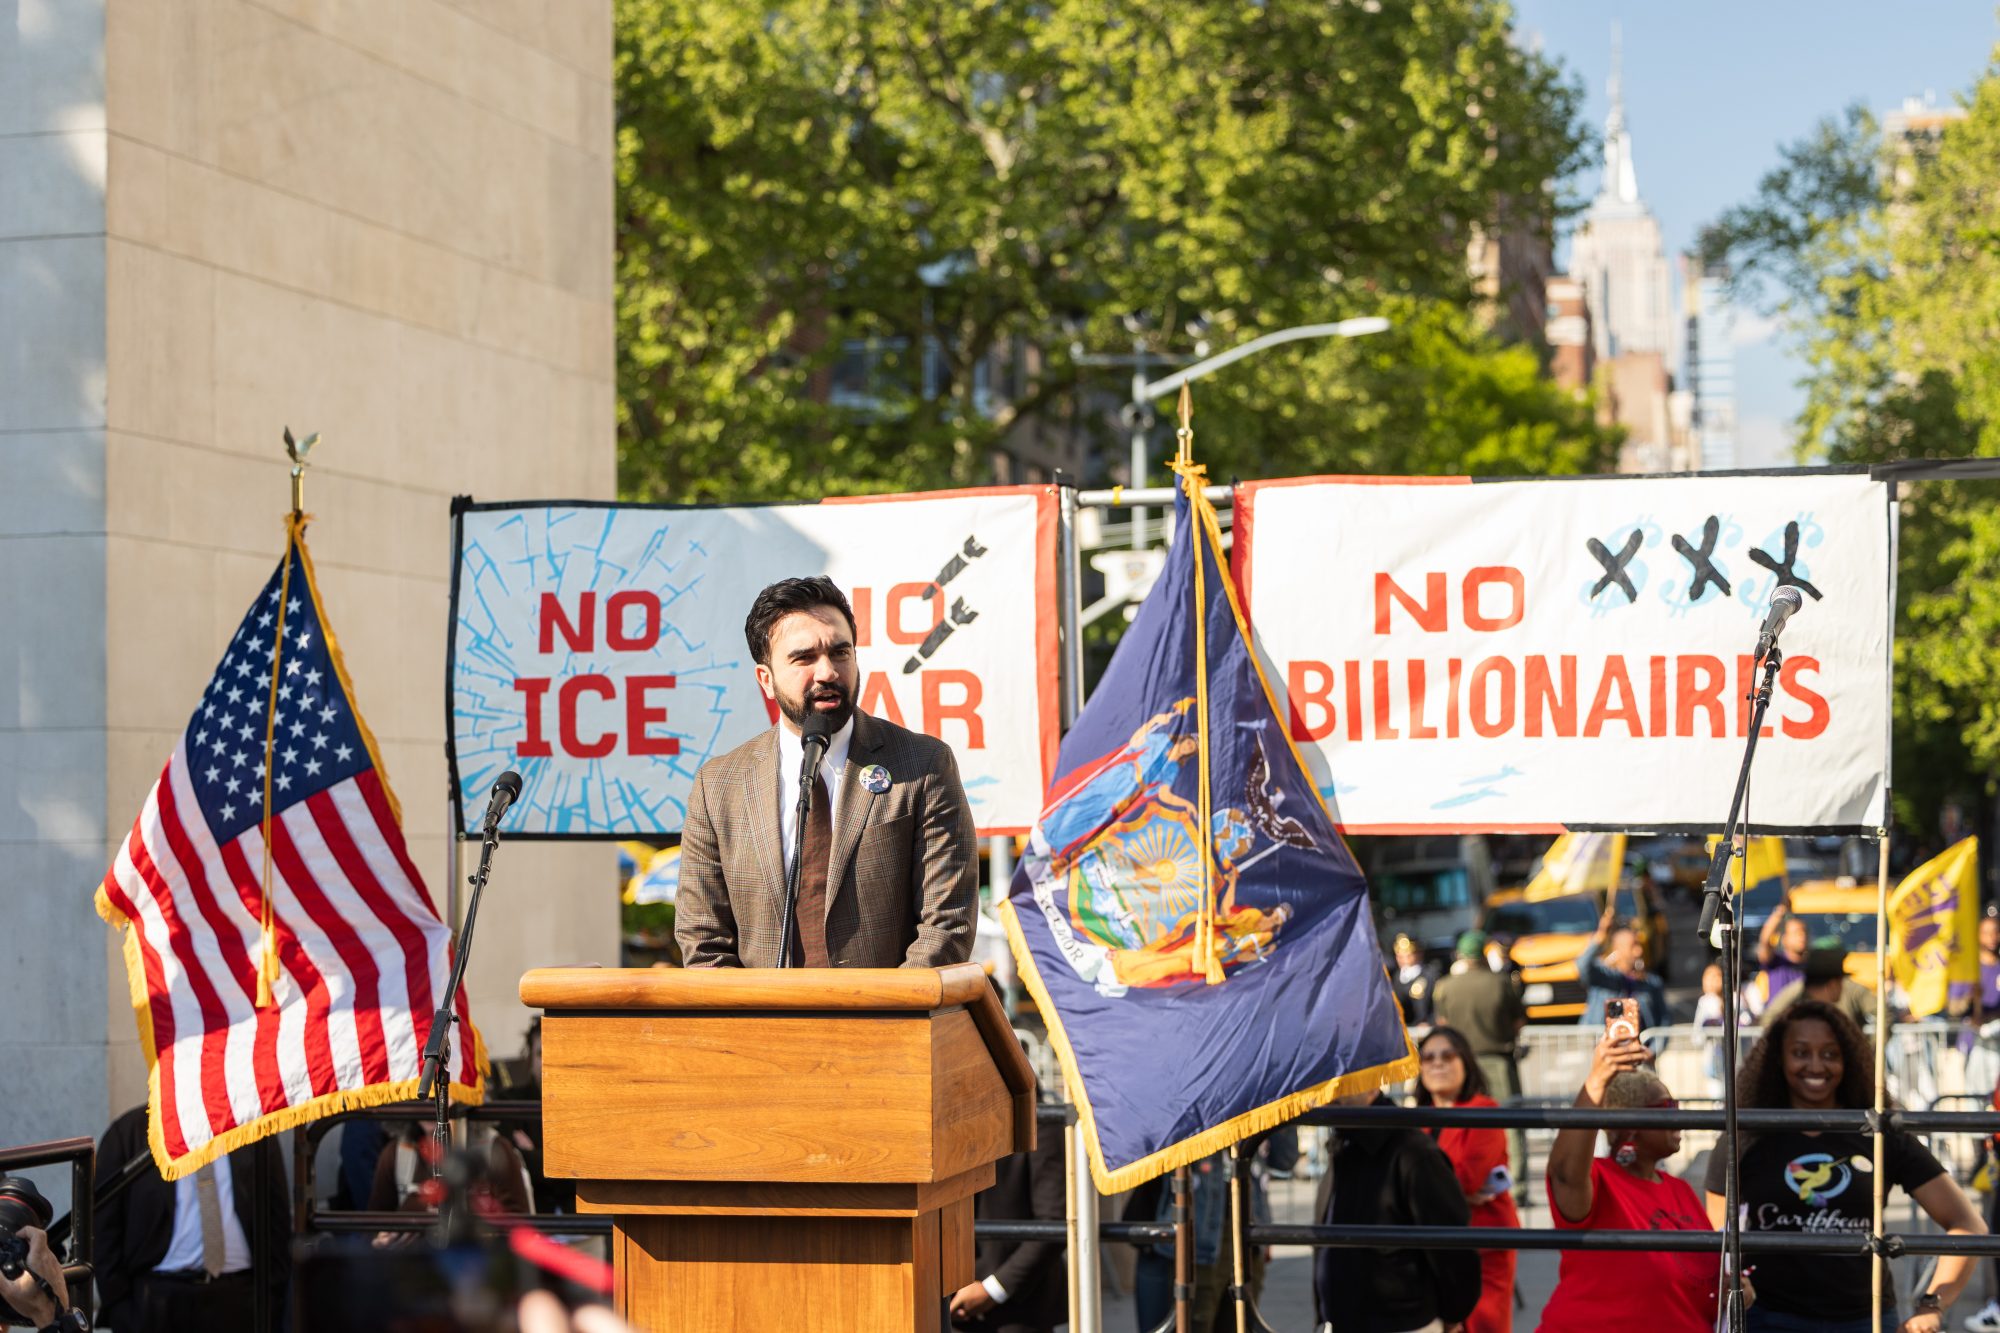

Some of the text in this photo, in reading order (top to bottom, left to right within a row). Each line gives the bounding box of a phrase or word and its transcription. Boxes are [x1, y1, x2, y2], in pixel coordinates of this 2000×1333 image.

[539, 590, 661, 653] NO
[1375, 566, 1524, 634] NO
[514, 674, 680, 758] ICE
[760, 669, 985, 749] AR
[1287, 655, 1831, 742] BILLIONAIRES
